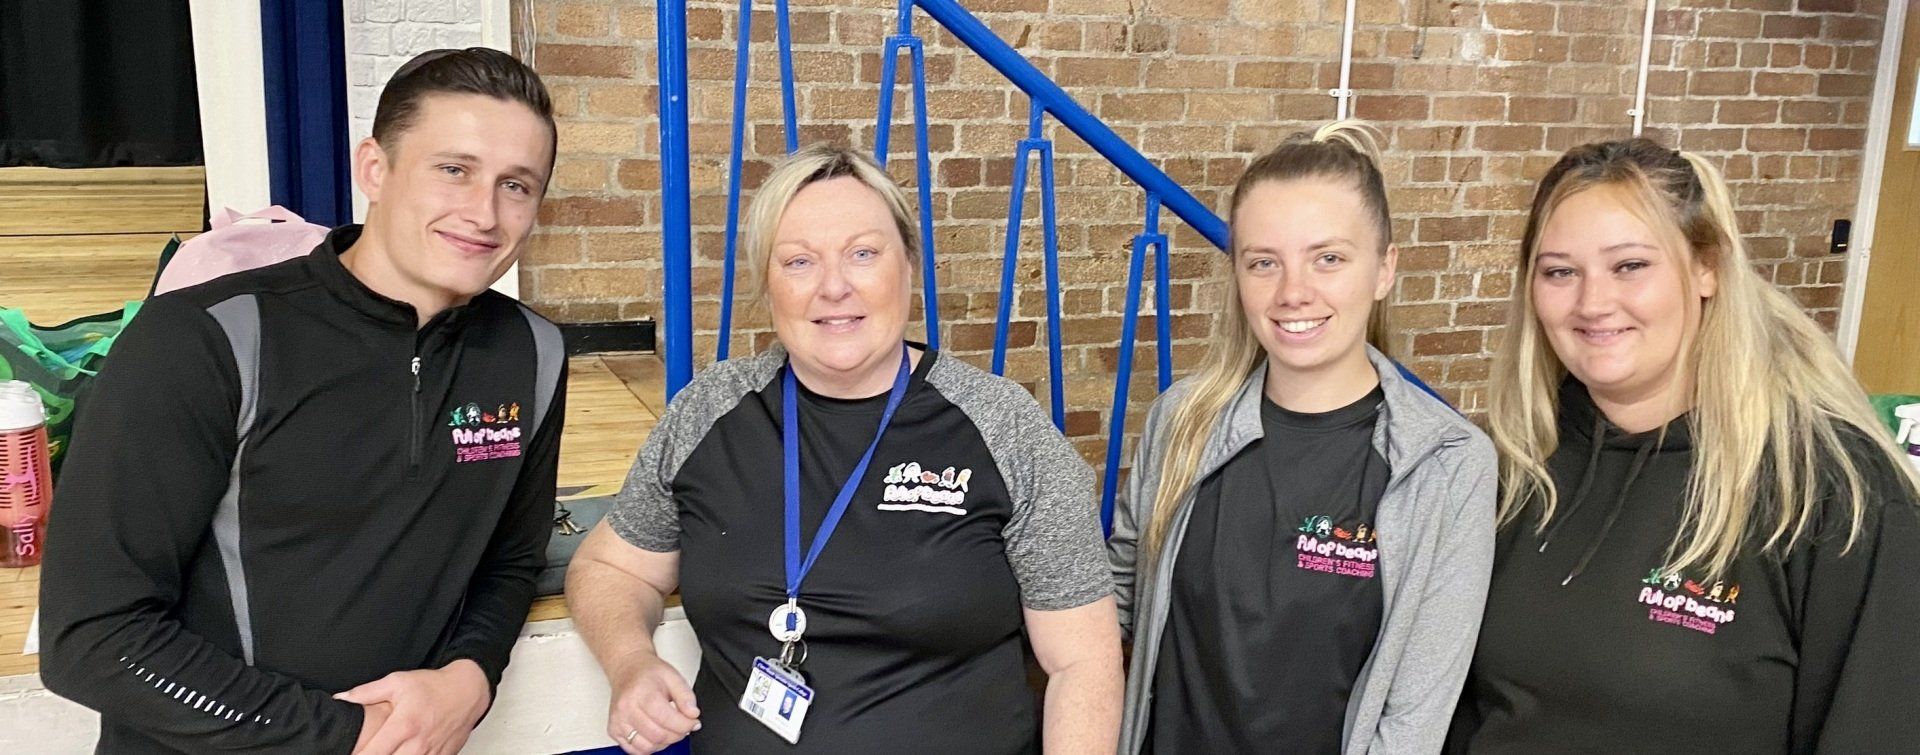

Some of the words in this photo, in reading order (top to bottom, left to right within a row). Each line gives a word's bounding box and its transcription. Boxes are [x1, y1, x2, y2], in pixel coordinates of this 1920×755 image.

[13, 513, 38, 556] Sally
[1336, 543, 1378, 562] beans
[1305, 561, 1333, 573] SPORTS
[1685, 597, 1735, 624] beans
